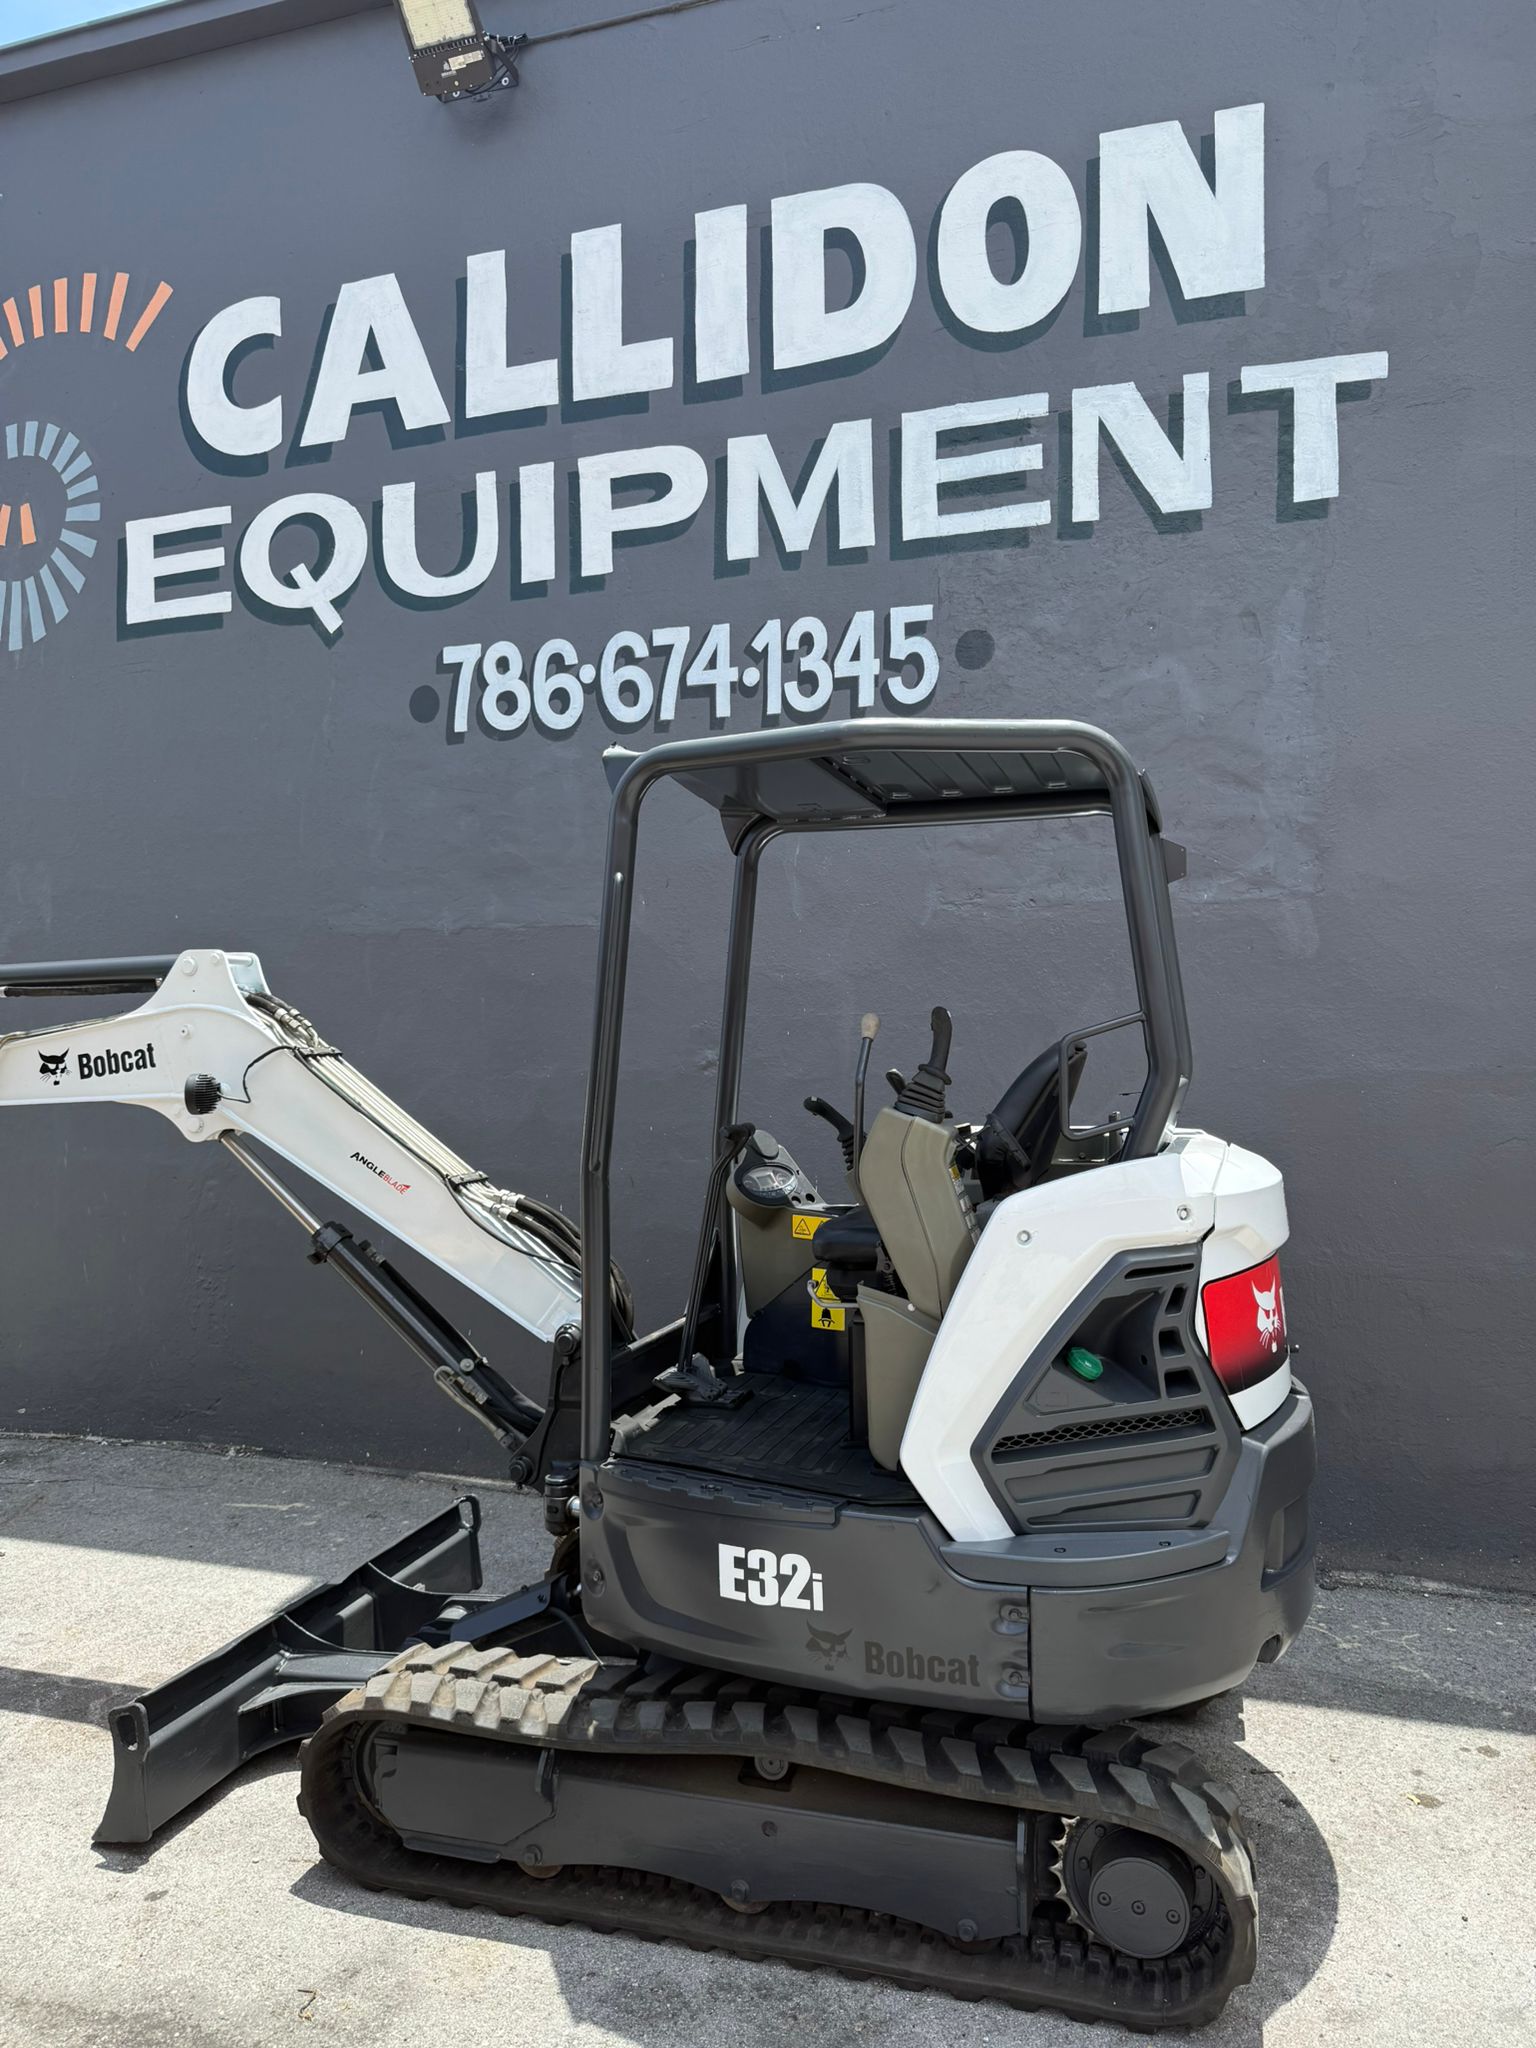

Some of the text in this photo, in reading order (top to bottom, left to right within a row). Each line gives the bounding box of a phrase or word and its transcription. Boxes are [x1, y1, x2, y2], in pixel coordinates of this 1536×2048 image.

[186, 102, 1266, 457] CALLIDON
[125, 351, 1389, 634] EQUIPMENT
[77, 1042, 156, 1080] Bobcat
[718, 1543, 824, 1612] E32i
[864, 1640, 981, 1687] Bobcat
